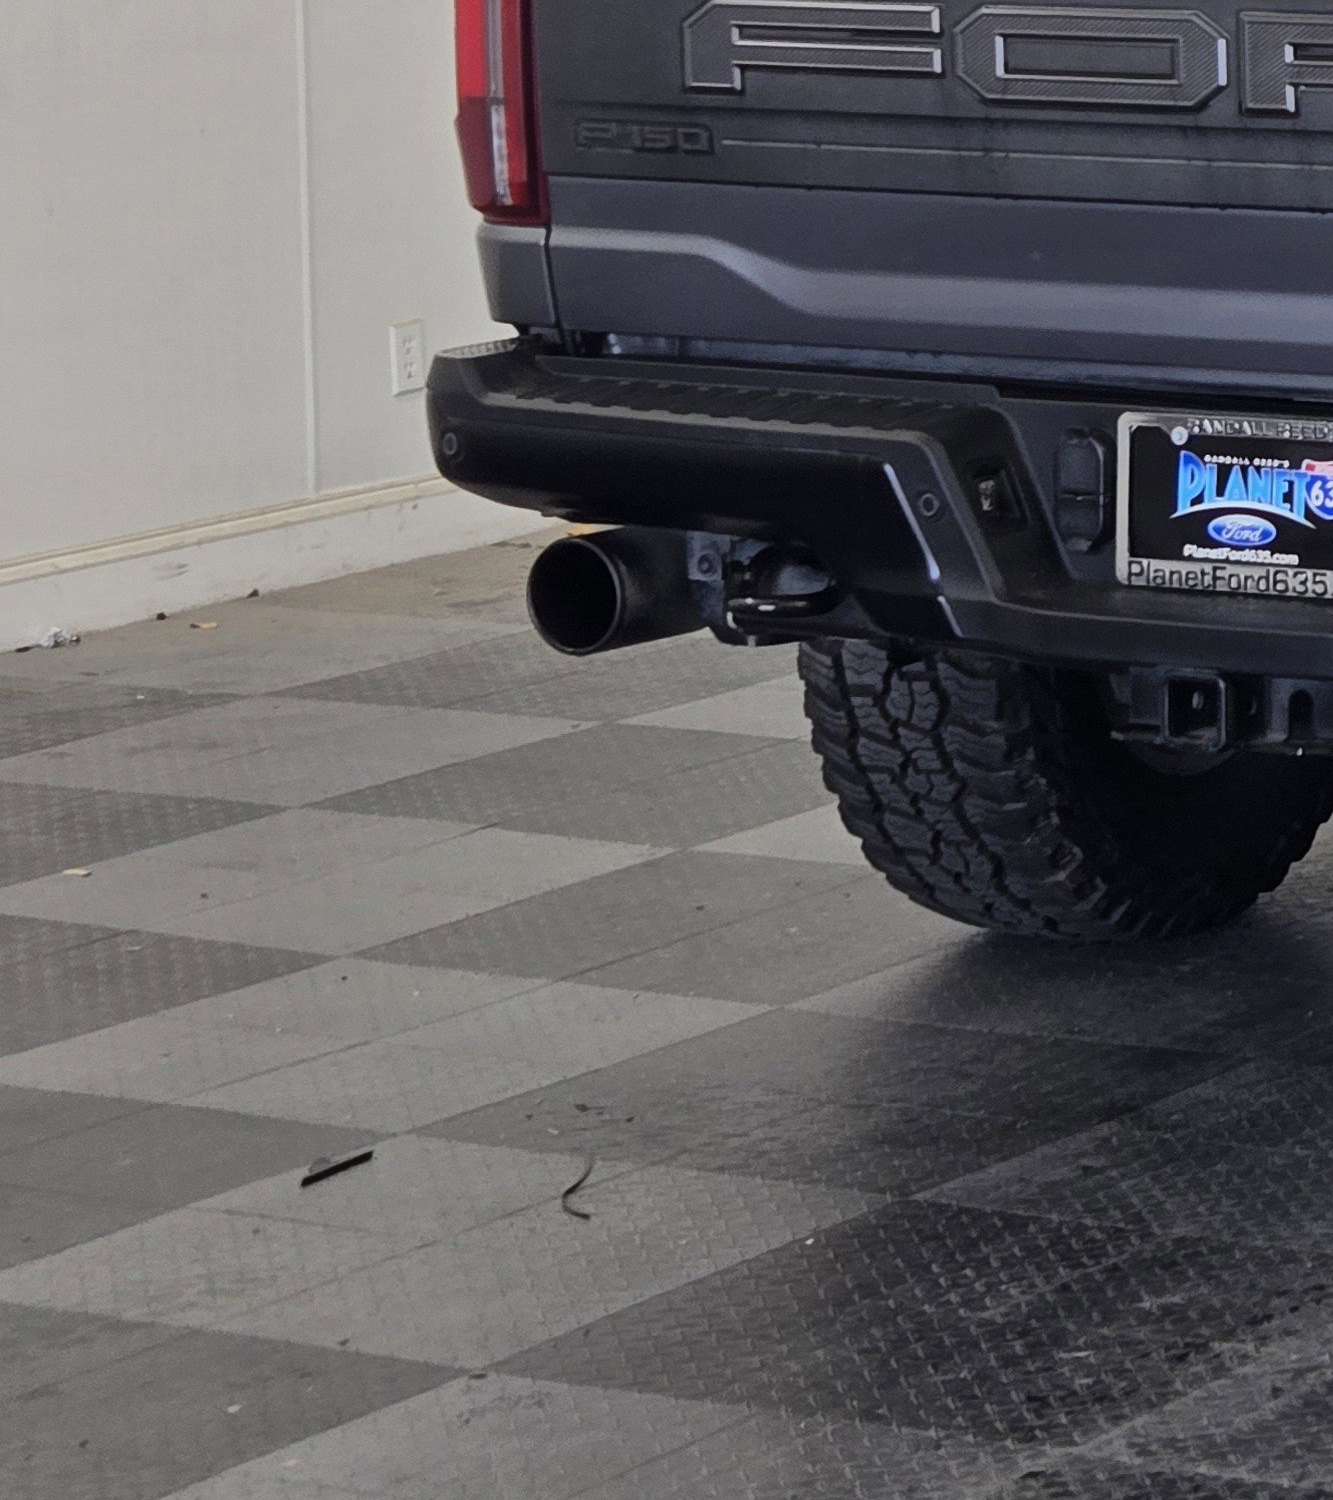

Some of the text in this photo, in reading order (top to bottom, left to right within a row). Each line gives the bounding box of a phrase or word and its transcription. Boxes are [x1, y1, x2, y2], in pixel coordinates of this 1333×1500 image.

[1187, 417, 1273, 438] RANDALL
[1177, 450, 1311, 521] PLANET
[1221, 521, 1265, 542] Ford
